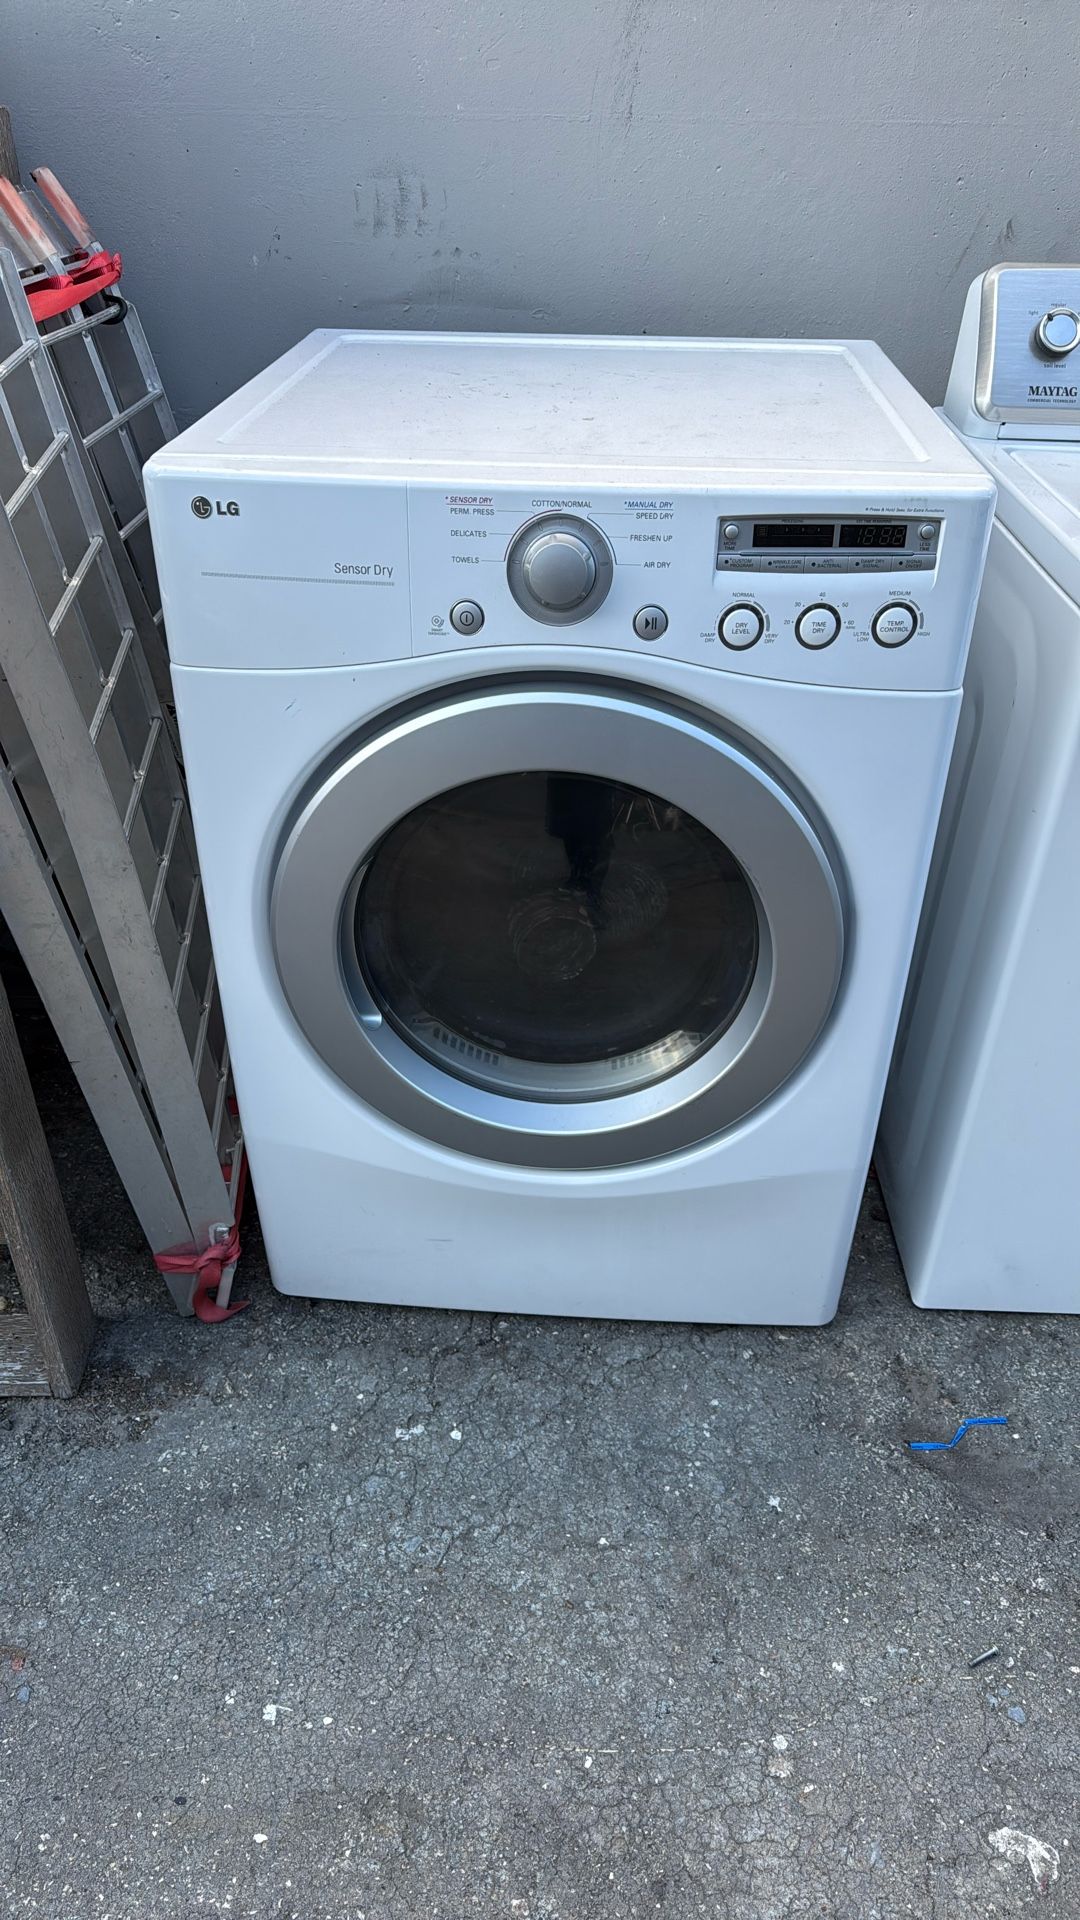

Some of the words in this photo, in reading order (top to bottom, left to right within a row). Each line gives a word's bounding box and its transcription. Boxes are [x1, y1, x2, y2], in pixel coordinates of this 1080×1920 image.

[1028, 386, 1078, 397] MAYTAG
[216, 500, 240, 516] LG
[531, 500, 592, 508] COTTON/NORMAL
[473, 508, 495, 516] PRESS
[450, 529, 487, 537] DELICATES
[334, 562, 371, 576] Sensor
[373, 564, 394, 578] Dry
